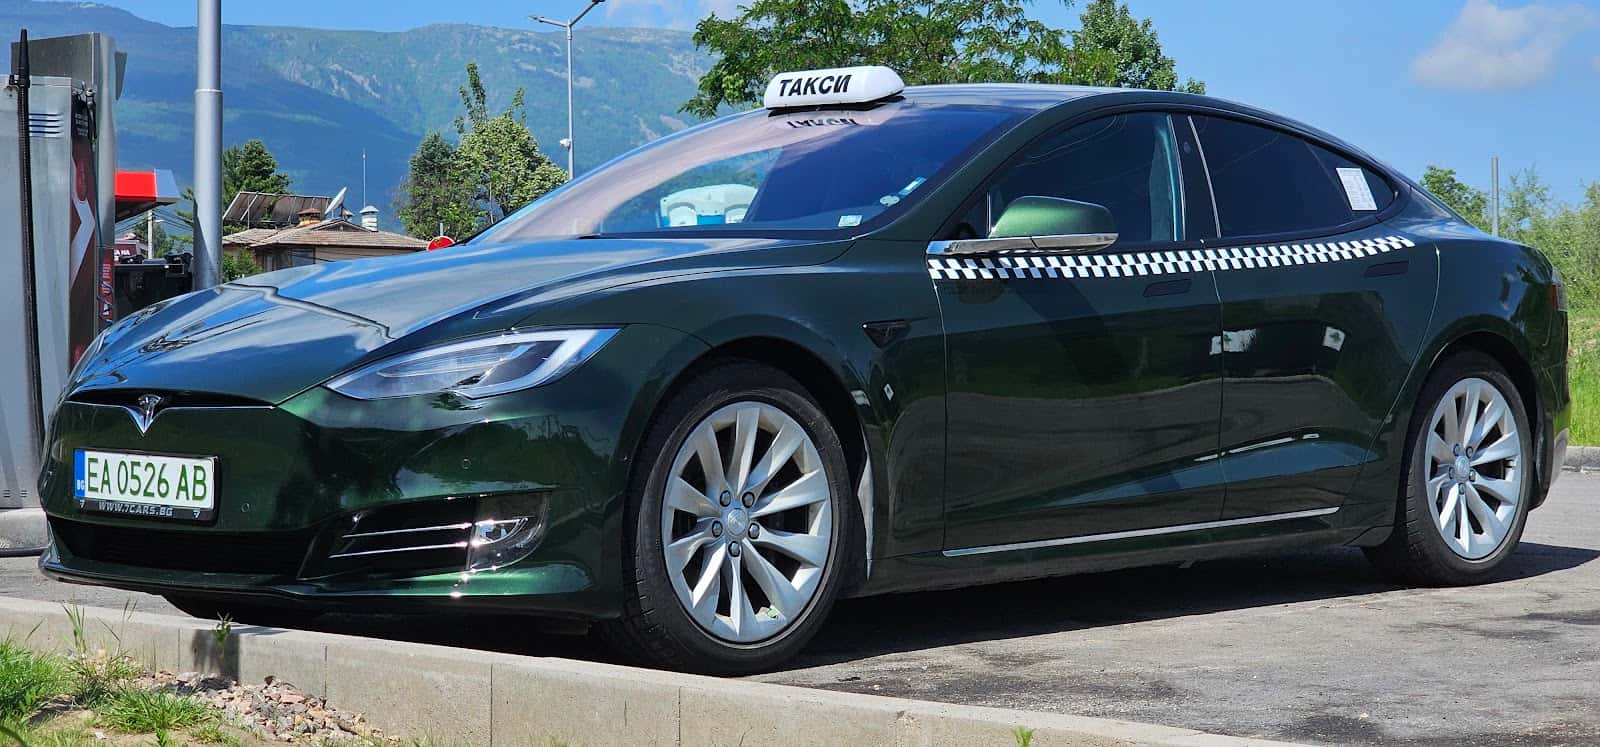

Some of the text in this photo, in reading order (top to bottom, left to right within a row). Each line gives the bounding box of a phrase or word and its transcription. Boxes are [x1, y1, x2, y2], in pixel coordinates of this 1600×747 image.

[780, 74, 853, 97] ТАКСИ
[77, 479, 85, 491] BG
[87, 457, 207, 501] EA 0526 AB
[98, 501, 174, 517] WWW.7CARS.BG
